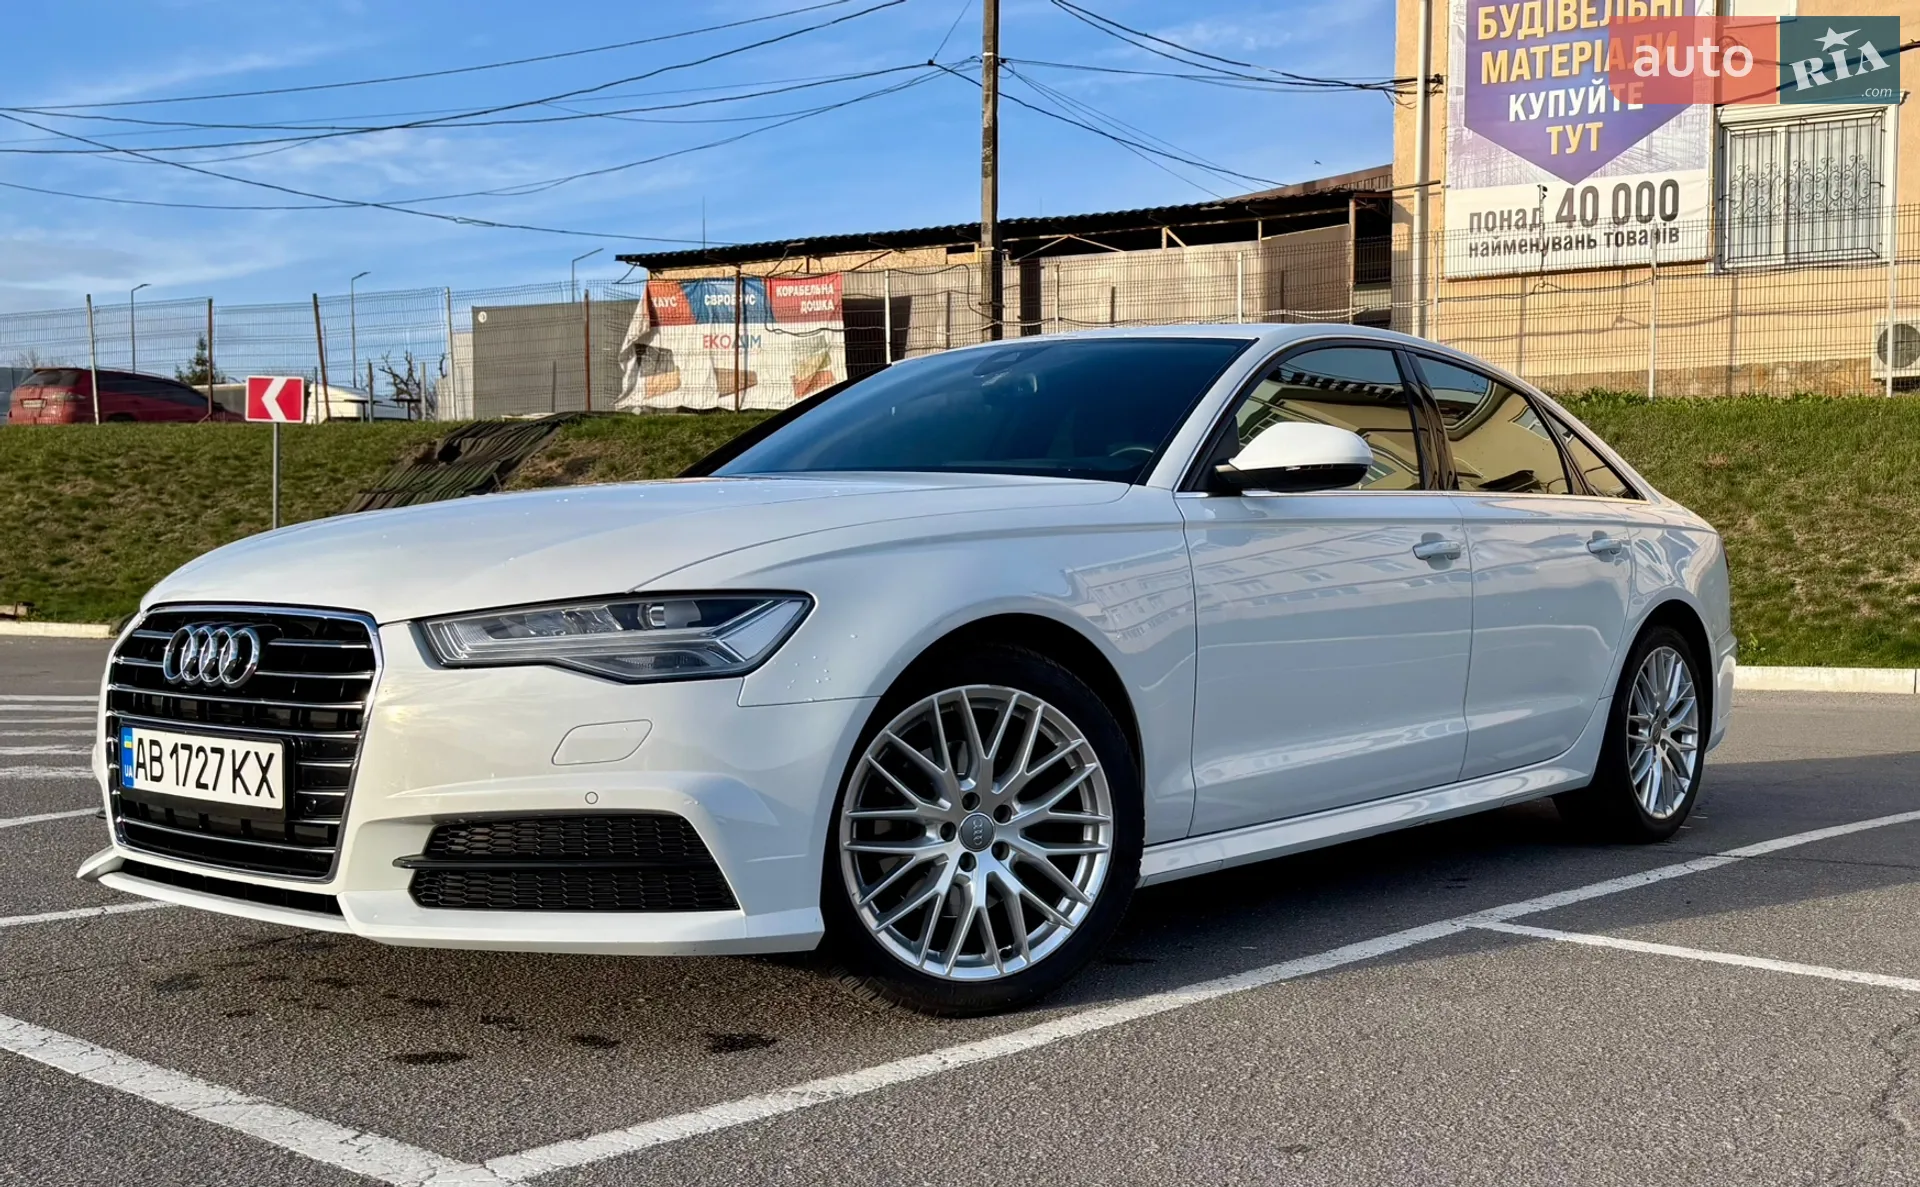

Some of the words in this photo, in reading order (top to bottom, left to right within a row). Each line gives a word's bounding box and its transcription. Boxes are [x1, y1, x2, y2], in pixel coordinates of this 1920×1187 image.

[1481, 31, 1680, 85] МАТЕРІАЛИ
[1509, 78, 1645, 122] КУПУЙТЕ
[1545, 122, 1604, 156] ТУТ
[1469, 207, 1546, 234] понад
[1555, 185, 1600, 229] 40
[1611, 179, 1680, 226] 000
[1469, 232, 1597, 259] найменувань
[775, 283, 834, 298] КОРАБЕЛЬНА
[800, 300, 835, 315] ДОШКА
[124, 765, 133, 778] UA
[135, 737, 164, 783] AB
[169, 742, 225, 792] 1727
[231, 748, 276, 799] KX
